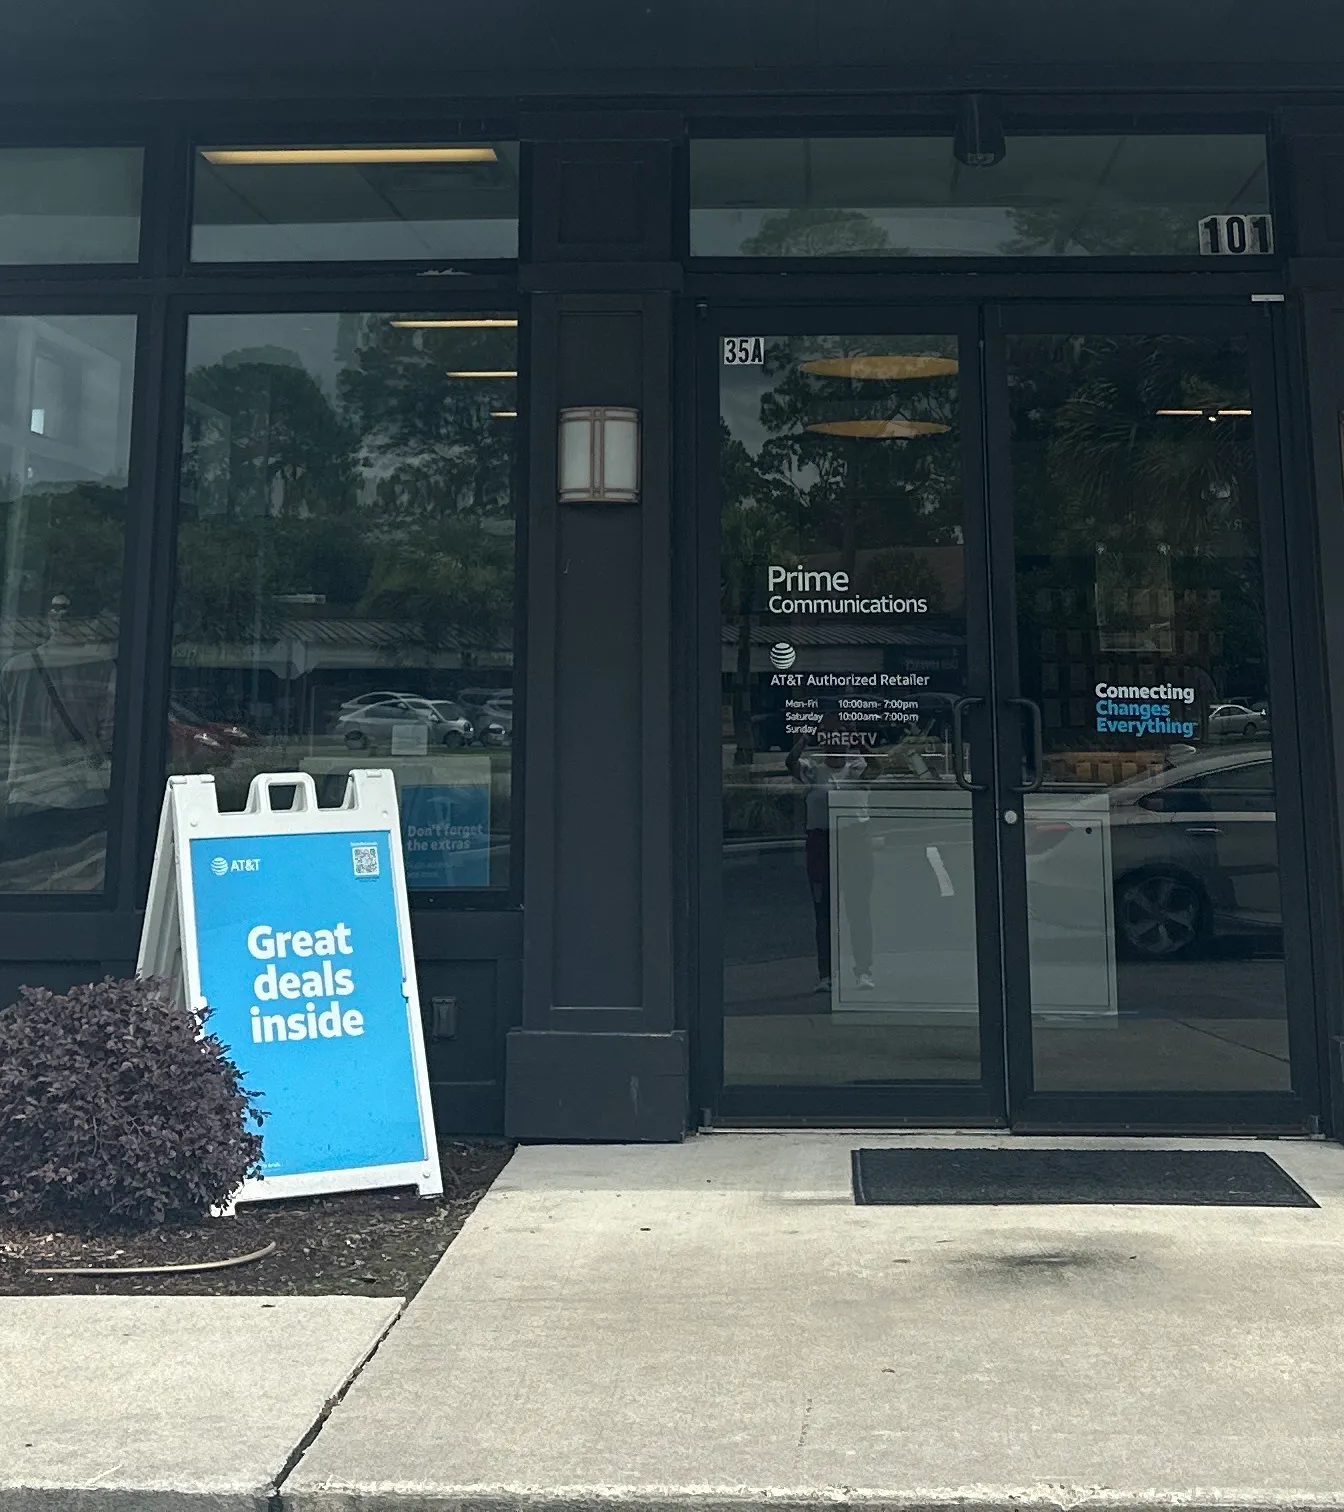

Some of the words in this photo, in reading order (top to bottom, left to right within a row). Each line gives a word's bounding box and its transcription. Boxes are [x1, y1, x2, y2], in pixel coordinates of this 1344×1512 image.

[1203, 216, 1269, 254] 101
[725, 338, 763, 364] 35A
[767, 564, 850, 592] Prime
[768, 594, 928, 614] Communications
[770, 674, 804, 687] AT&T
[806, 673, 878, 687] Authorized
[880, 673, 931, 687] Retailer
[1095, 682, 1196, 704] Connecting
[785, 699, 819, 709] Mon-Fri
[883, 699, 919, 711] 7:00pm
[1095, 699, 1171, 720] Changes
[785, 711, 824, 723] Saturday
[883, 712, 919, 723] 7:00pm
[1096, 716, 1195, 738] Everything
[785, 724, 818, 736] Sunday
[817, 731, 878, 746] DIRECTV
[407, 823, 442, 838] Don't
[443, 823, 484, 839] forget
[407, 838, 429, 852] the
[430, 839, 472, 851] extras
[230, 858, 262, 873] AT&T
[247, 921, 355, 961] Great
[253, 960, 355, 1002] deals
[249, 999, 365, 1044] inside
